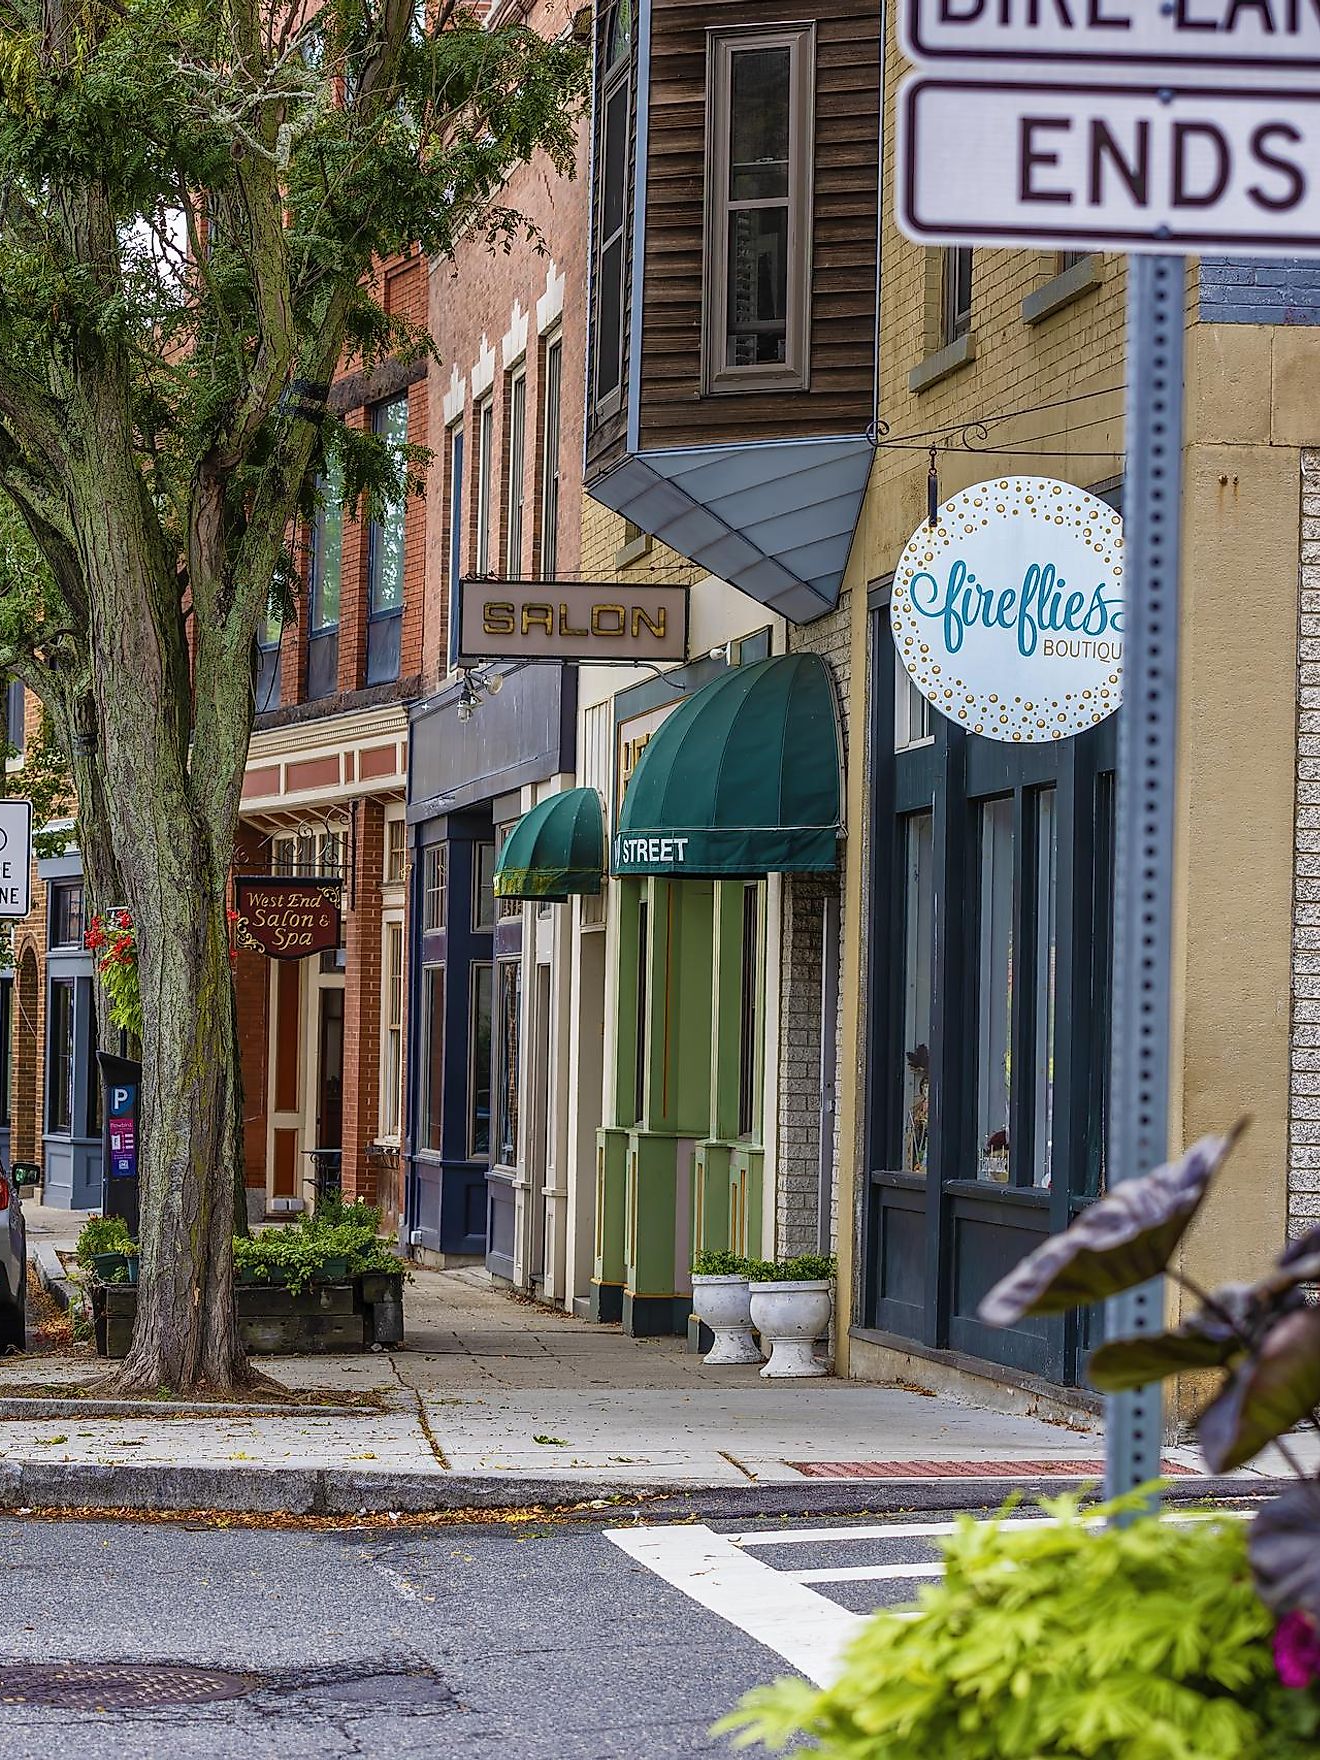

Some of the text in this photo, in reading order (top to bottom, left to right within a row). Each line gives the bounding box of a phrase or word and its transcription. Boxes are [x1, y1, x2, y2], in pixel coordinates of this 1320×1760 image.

[1019, 116, 1308, 212] ENDS
[482, 602, 666, 638] SALON
[910, 559, 1126, 657] fireflies
[1043, 639, 1123, 663] BOUTIQU
[623, 837, 688, 863] STREET
[246, 892, 323, 908] West End
[252, 908, 331, 928] Salon &
[271, 927, 314, 951] Spa
[113, 1088, 129, 1110] P
